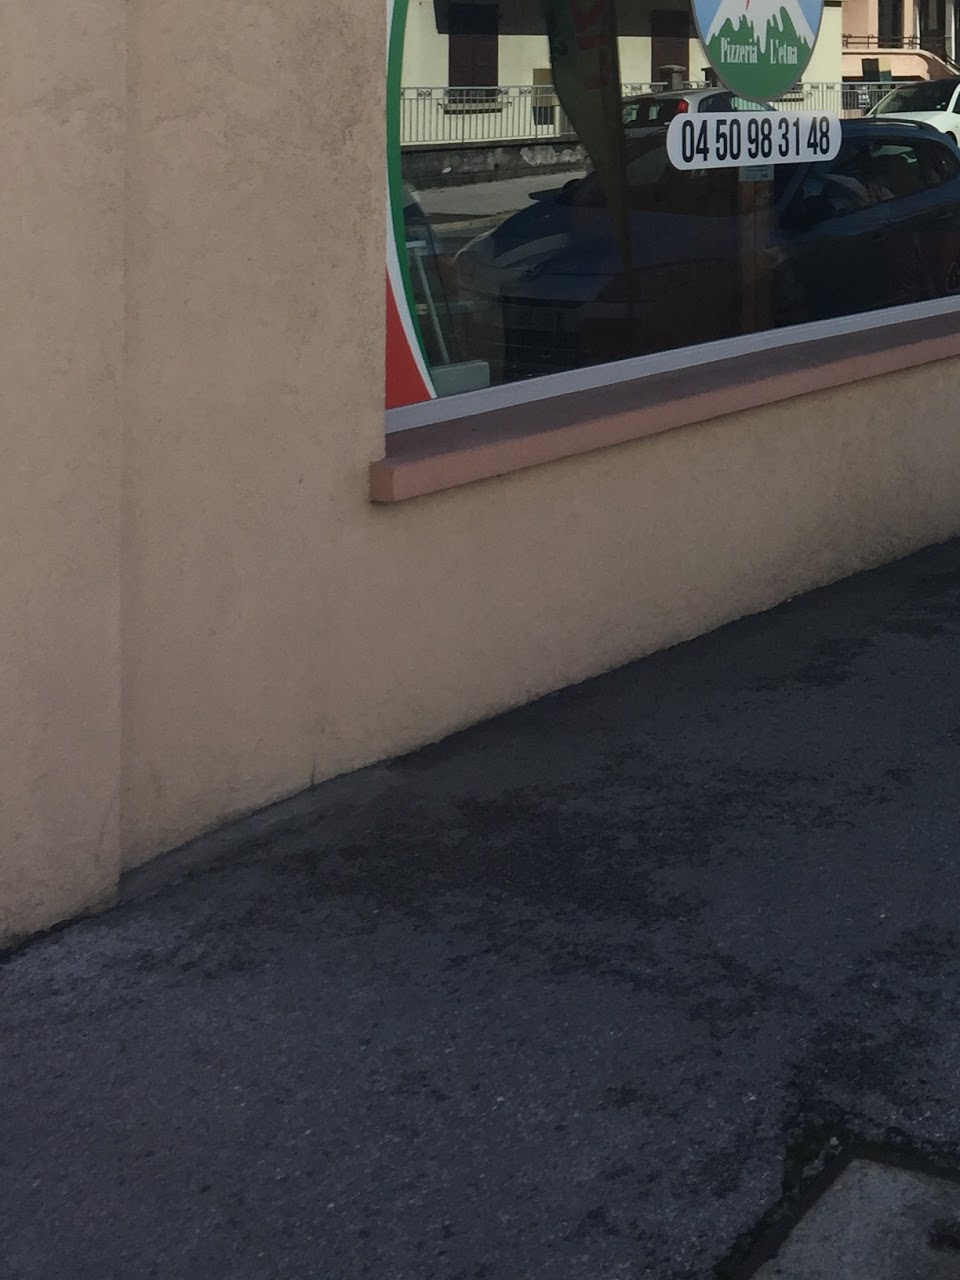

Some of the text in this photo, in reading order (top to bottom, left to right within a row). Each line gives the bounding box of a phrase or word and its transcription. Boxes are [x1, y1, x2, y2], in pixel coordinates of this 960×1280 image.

[720, 36, 799, 66] Pizzeria L'etna
[681, 115, 830, 163] 04 50 98 31 48
